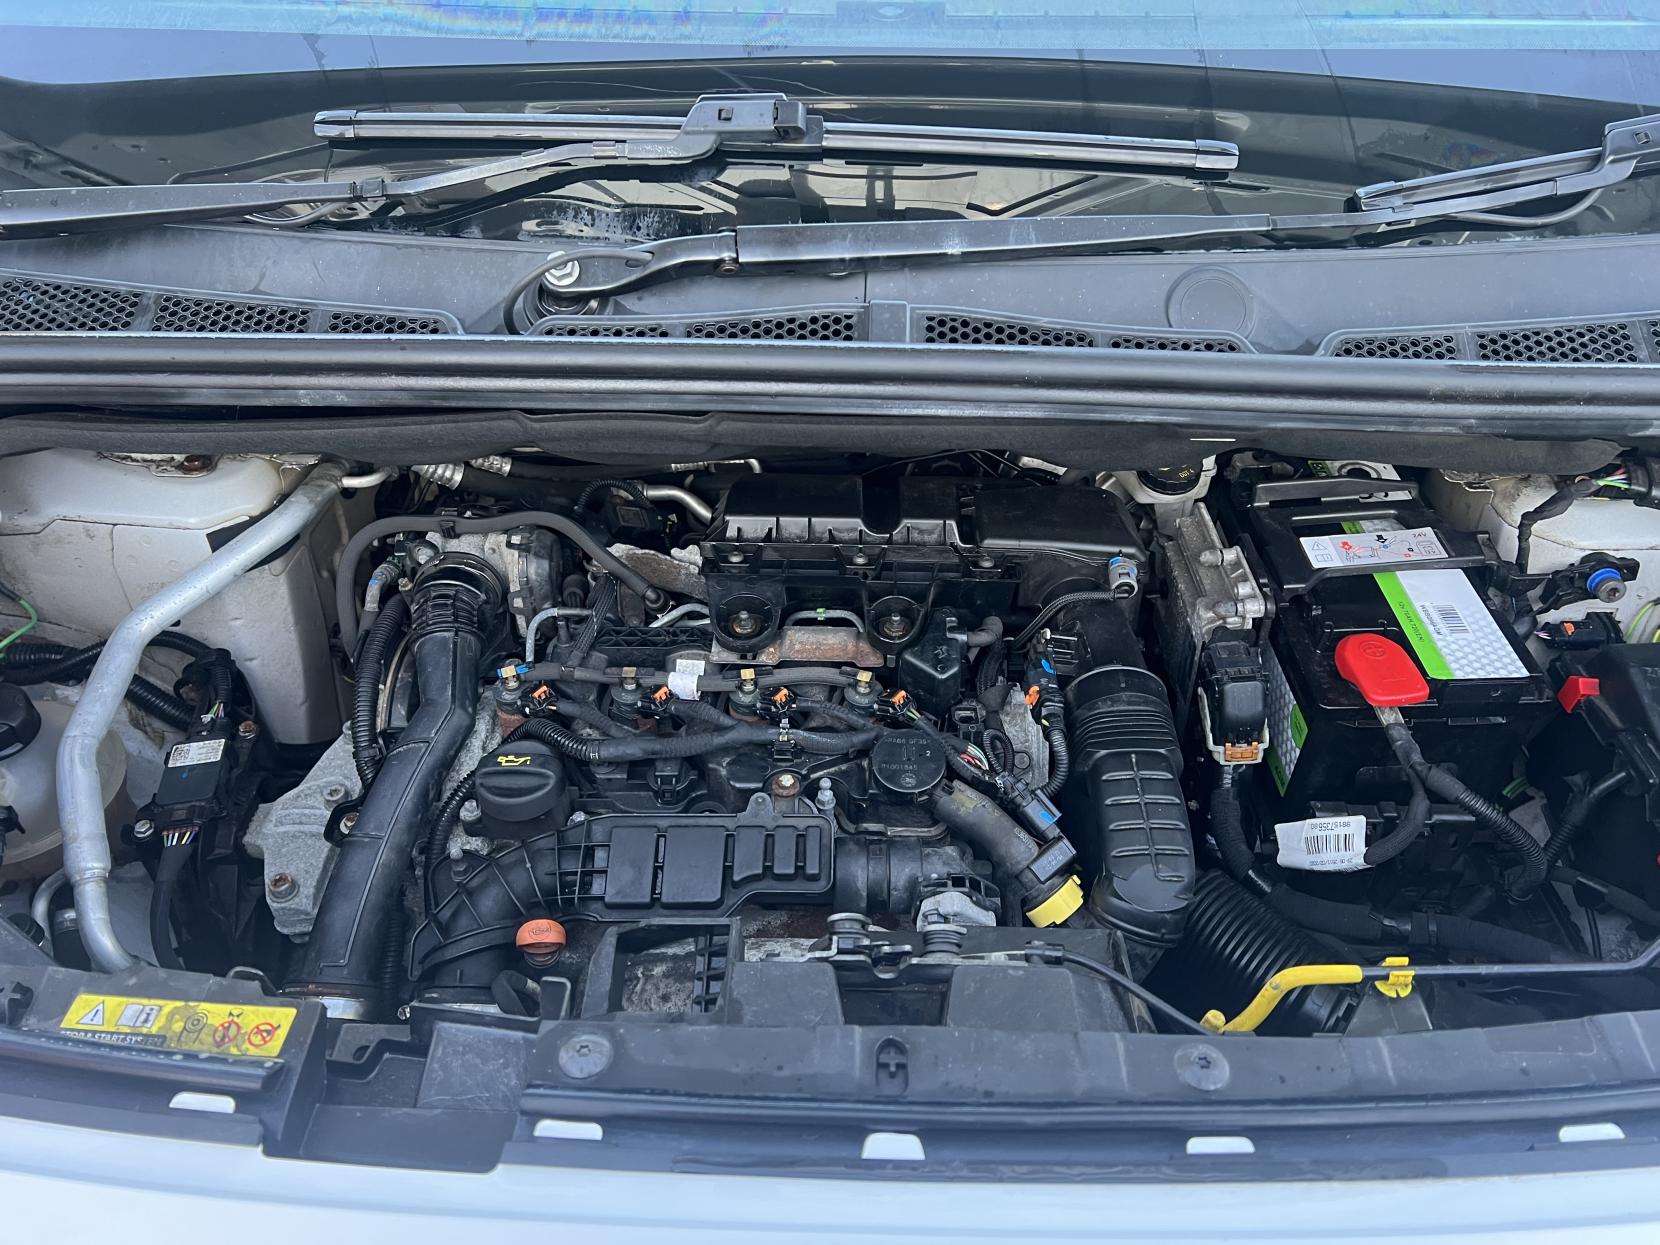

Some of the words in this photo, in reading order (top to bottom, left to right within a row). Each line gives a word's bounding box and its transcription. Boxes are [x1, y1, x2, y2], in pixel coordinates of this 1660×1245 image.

[1179, 470, 1190, 478] DOT
[94, 1033, 123, 1043] START
[125, 1035, 163, 1046] SYSEM
